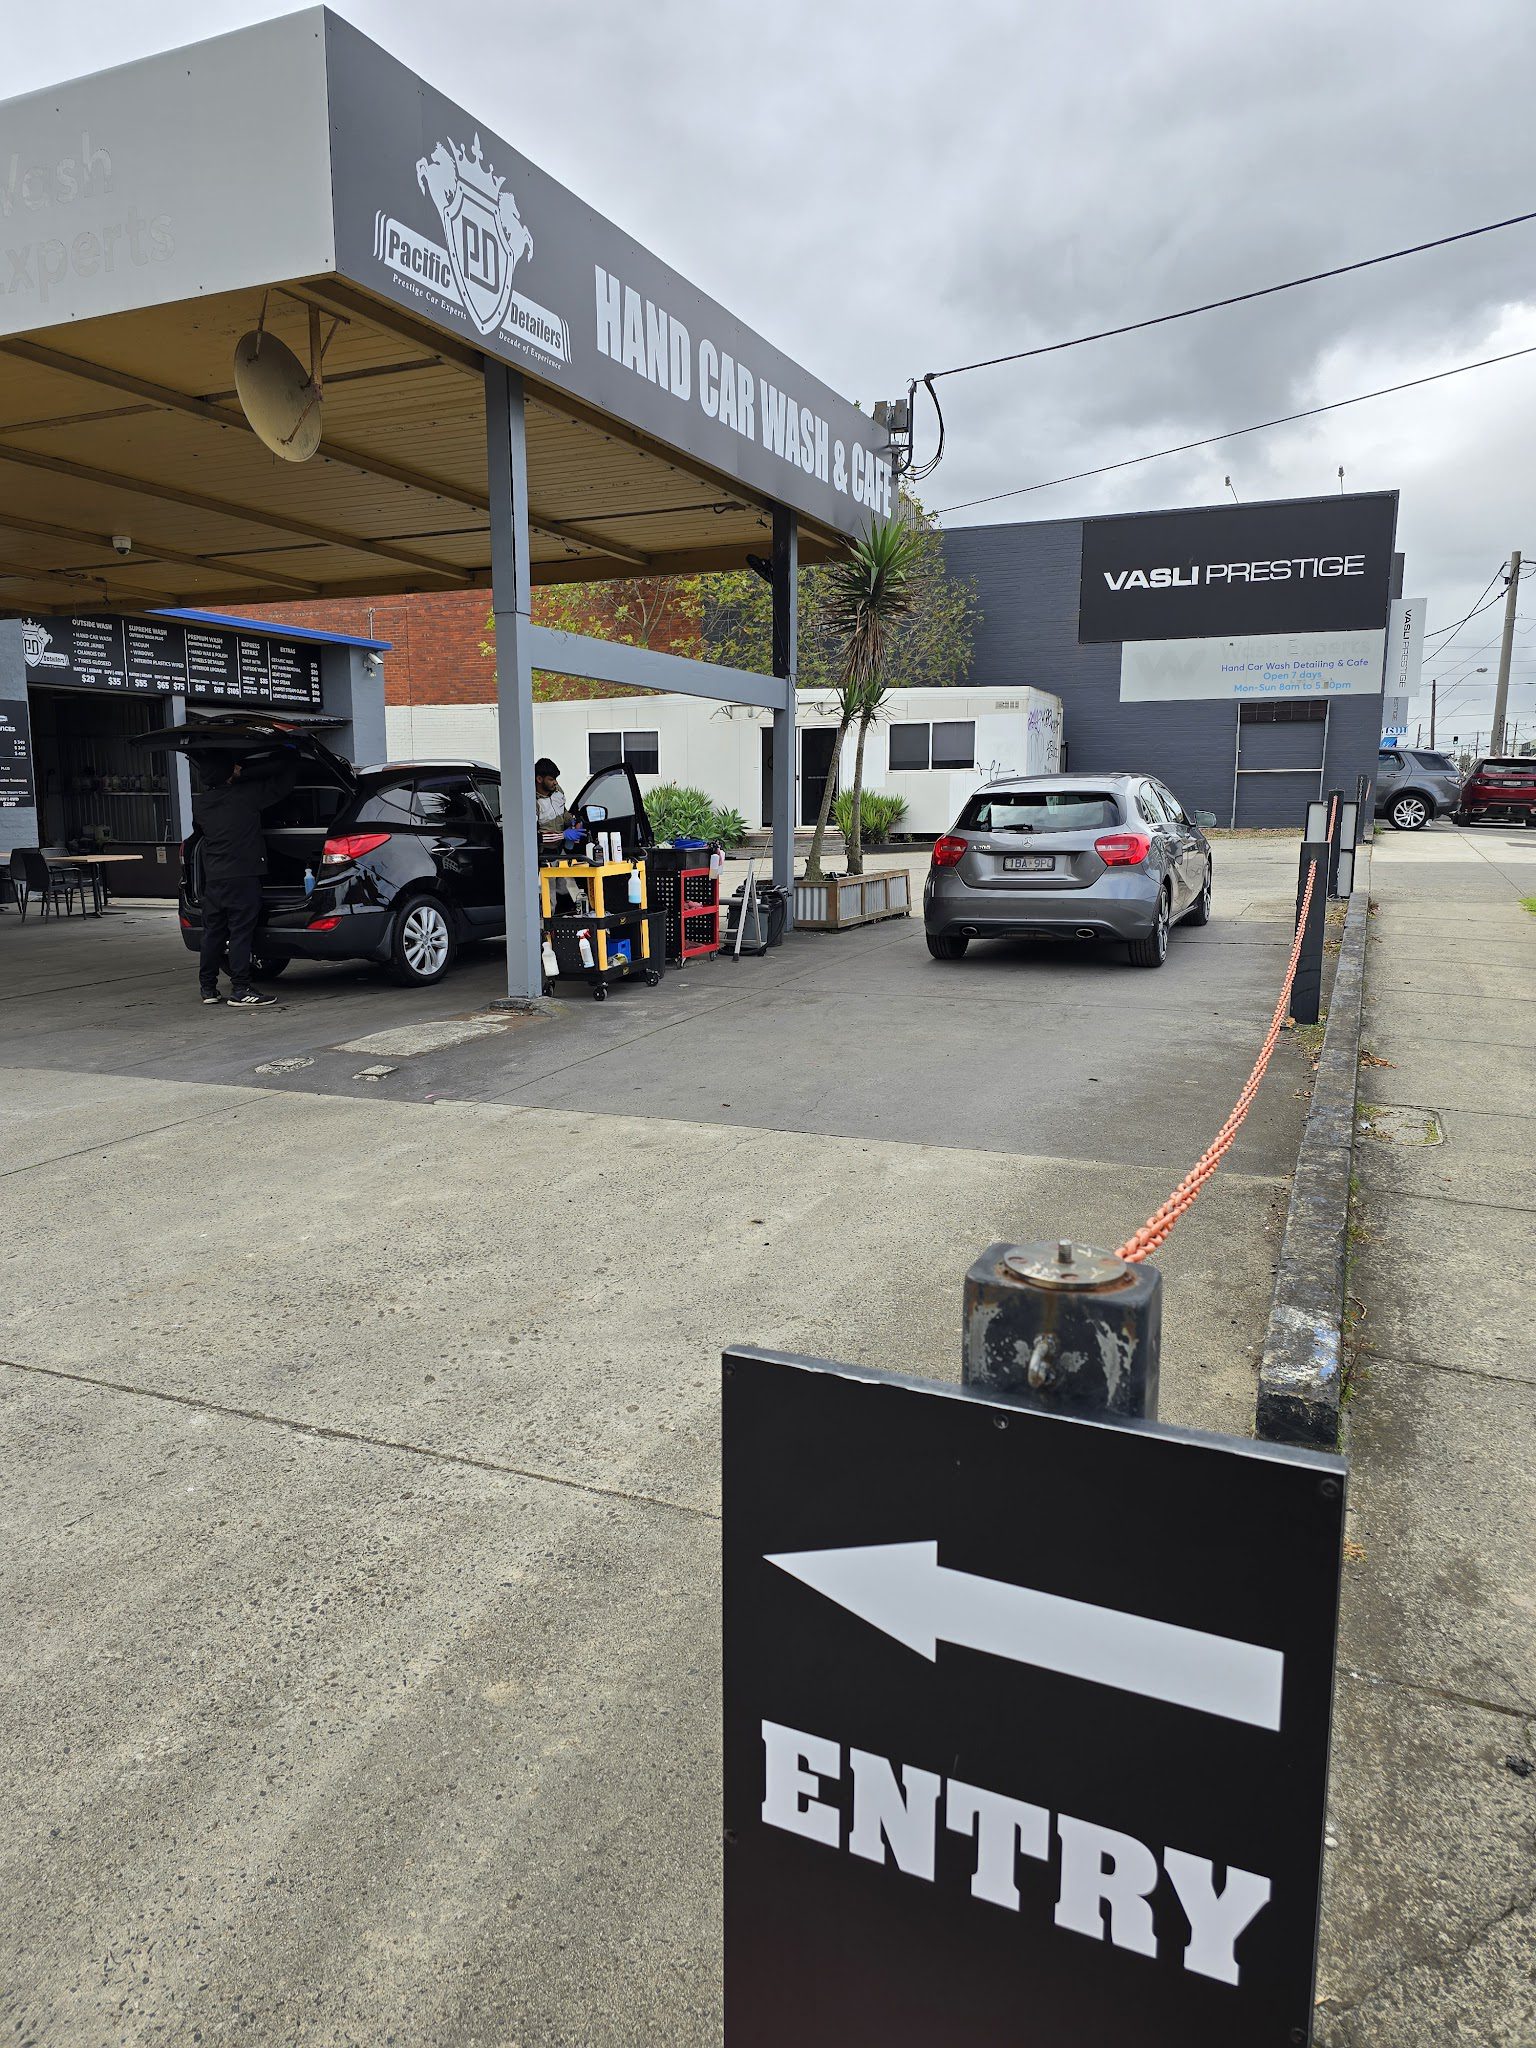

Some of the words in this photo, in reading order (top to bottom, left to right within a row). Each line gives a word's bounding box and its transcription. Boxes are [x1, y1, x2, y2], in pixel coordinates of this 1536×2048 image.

[389, 229, 450, 288] Pacific
[393, 274, 424, 297] Prestige
[426, 292, 438, 305] Car
[441, 301, 467, 321] Experts
[510, 302, 561, 349] Detailers
[499, 331, 521, 350] Decade
[522, 343, 529, 354] of
[531, 348, 561, 370] Experience
[595, 264, 690, 401] HAND
[700, 339, 754, 440] CAR
[760, 378, 828, 483] WASH
[833, 440, 848, 494] &
[852, 442, 892, 519] CAFE
[1104, 566, 1199, 590] VASLI
[1206, 554, 1365, 584] PRESTIGE
[72, 619, 95, 628] OUTSIDE
[96, 622, 112, 630] WASH
[129, 625, 152, 633] SUPREME
[188, 634, 208, 642] PREMIUM
[1403, 609, 1412, 639] VASLI
[1222, 664, 1244, 672] Hand
[1266, 662, 1290, 670] Wash
[1294, 660, 1334, 669] Detailing
[1347, 658, 1368, 666] Cafe
[1264, 672, 1288, 682] Open
[1300, 671, 1322, 680] days
[1399, 641, 1409, 688] PRESTIGE
[82, 674, 95, 683] $29
[108, 677, 121, 686] $35
[135, 679, 147, 687] $55
[157, 681, 169, 689] $65
[173, 682, 185, 690] $75
[1234, 684, 1276, 692] Mon-Sun
[761, 1718, 1271, 1986] ENTRY
